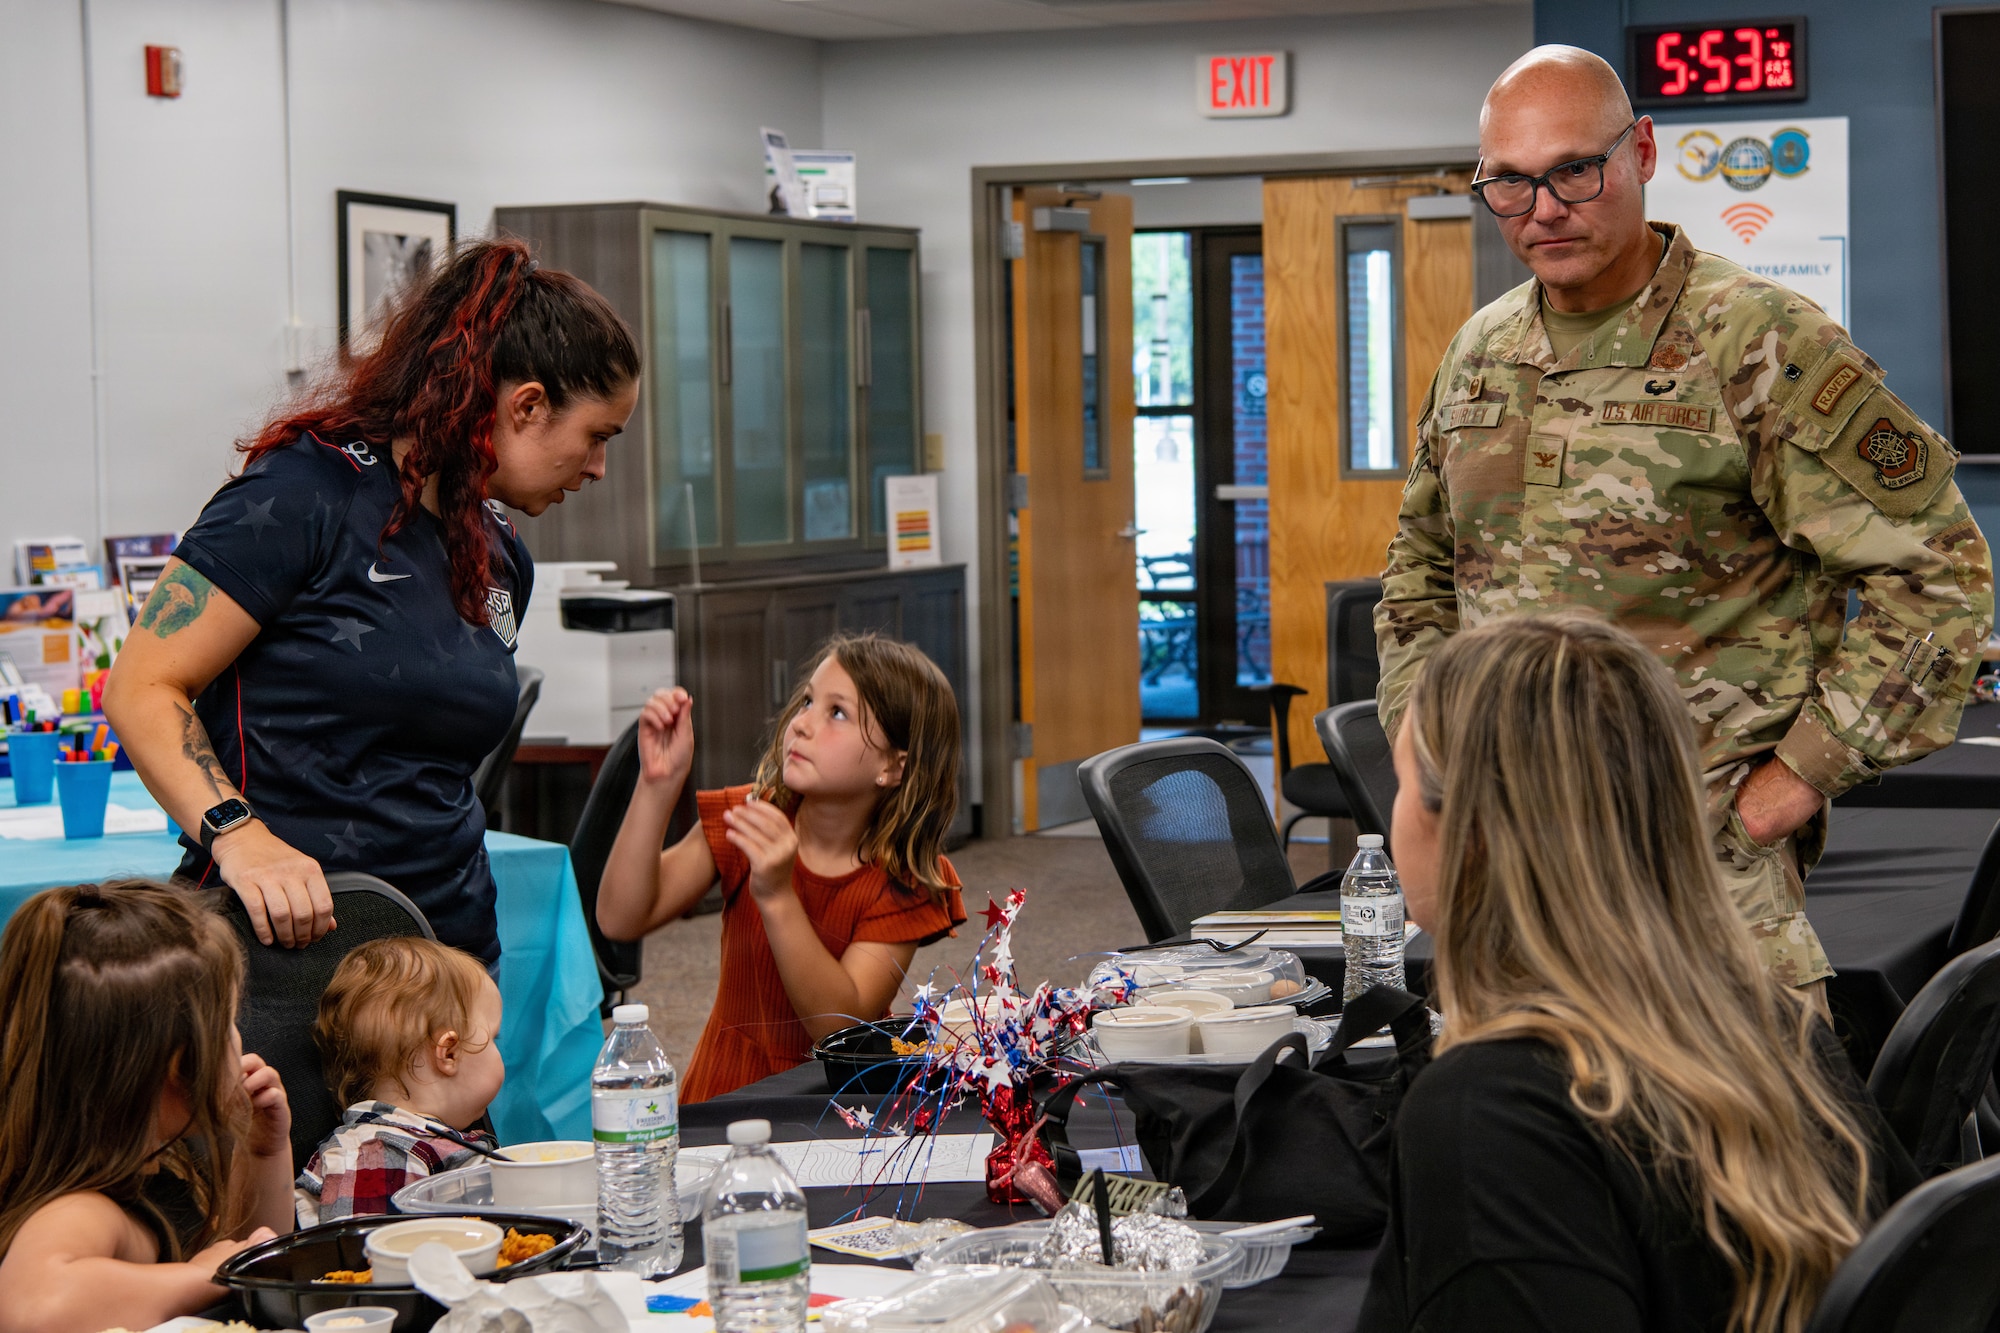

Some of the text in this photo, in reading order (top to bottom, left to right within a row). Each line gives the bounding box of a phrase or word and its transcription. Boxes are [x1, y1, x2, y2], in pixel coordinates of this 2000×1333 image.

[1656, 28, 1762, 95] 5:53
[1210, 56, 1275, 109] EXIT
[1745, 264, 1831, 276] ARY&FAMILY
[1819, 371, 1851, 406] RAVEN
[1602, 402, 1709, 429] U.S. AIR FORCE
[626, 1132, 650, 1142] Spring
